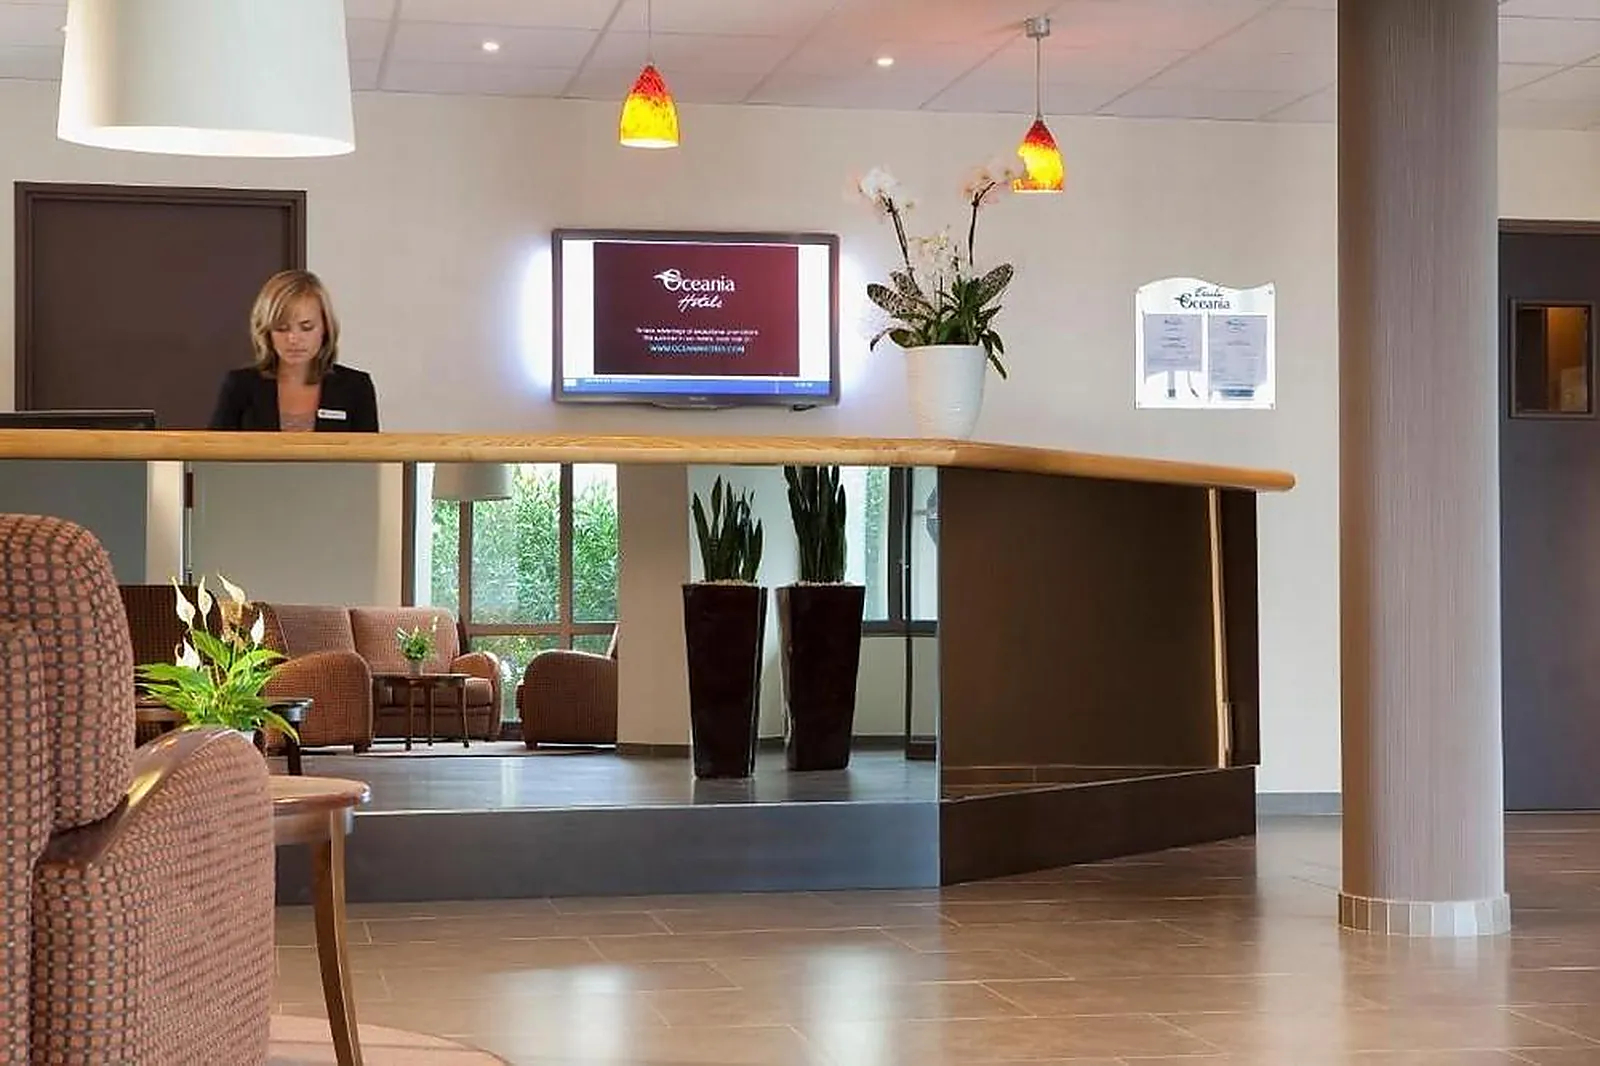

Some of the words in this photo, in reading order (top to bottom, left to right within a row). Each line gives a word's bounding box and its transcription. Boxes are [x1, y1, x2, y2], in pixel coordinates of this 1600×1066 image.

[654, 269, 735, 292] Oceania
[678, 294, 723, 312] Hotels
[1174, 293, 1231, 309] Oceania
